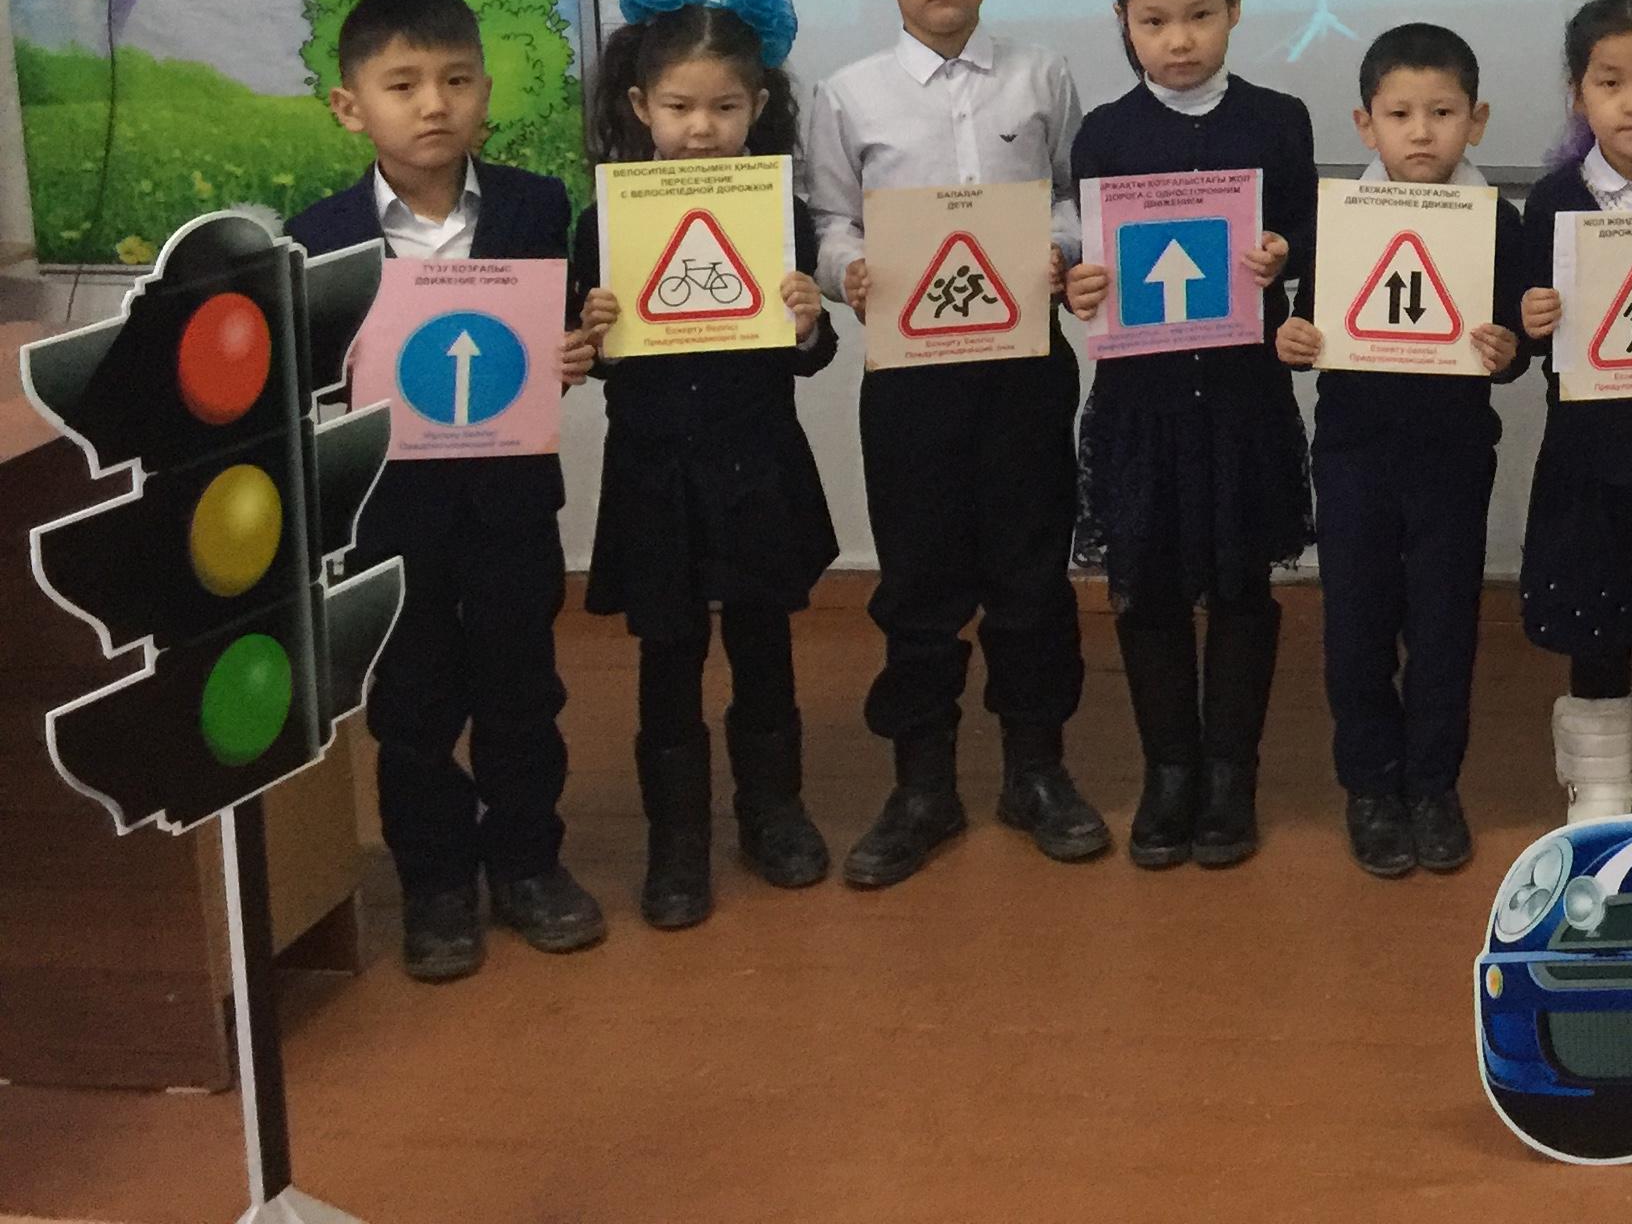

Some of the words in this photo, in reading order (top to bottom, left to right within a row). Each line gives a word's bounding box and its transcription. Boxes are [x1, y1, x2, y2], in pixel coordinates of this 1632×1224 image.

[613, 167, 676, 177] ВЕЛОСИПЕД
[661, 176, 733, 186] ПЕРЕСЕЧЕНИЕ
[630, 186, 714, 198] ВЕЛОСИПЕДНОЙ
[716, 183, 773, 194] ДОРОЖКОЙ
[937, 189, 983, 199] БАЛАЛАР
[947, 201, 973, 210] ДЕТИ
